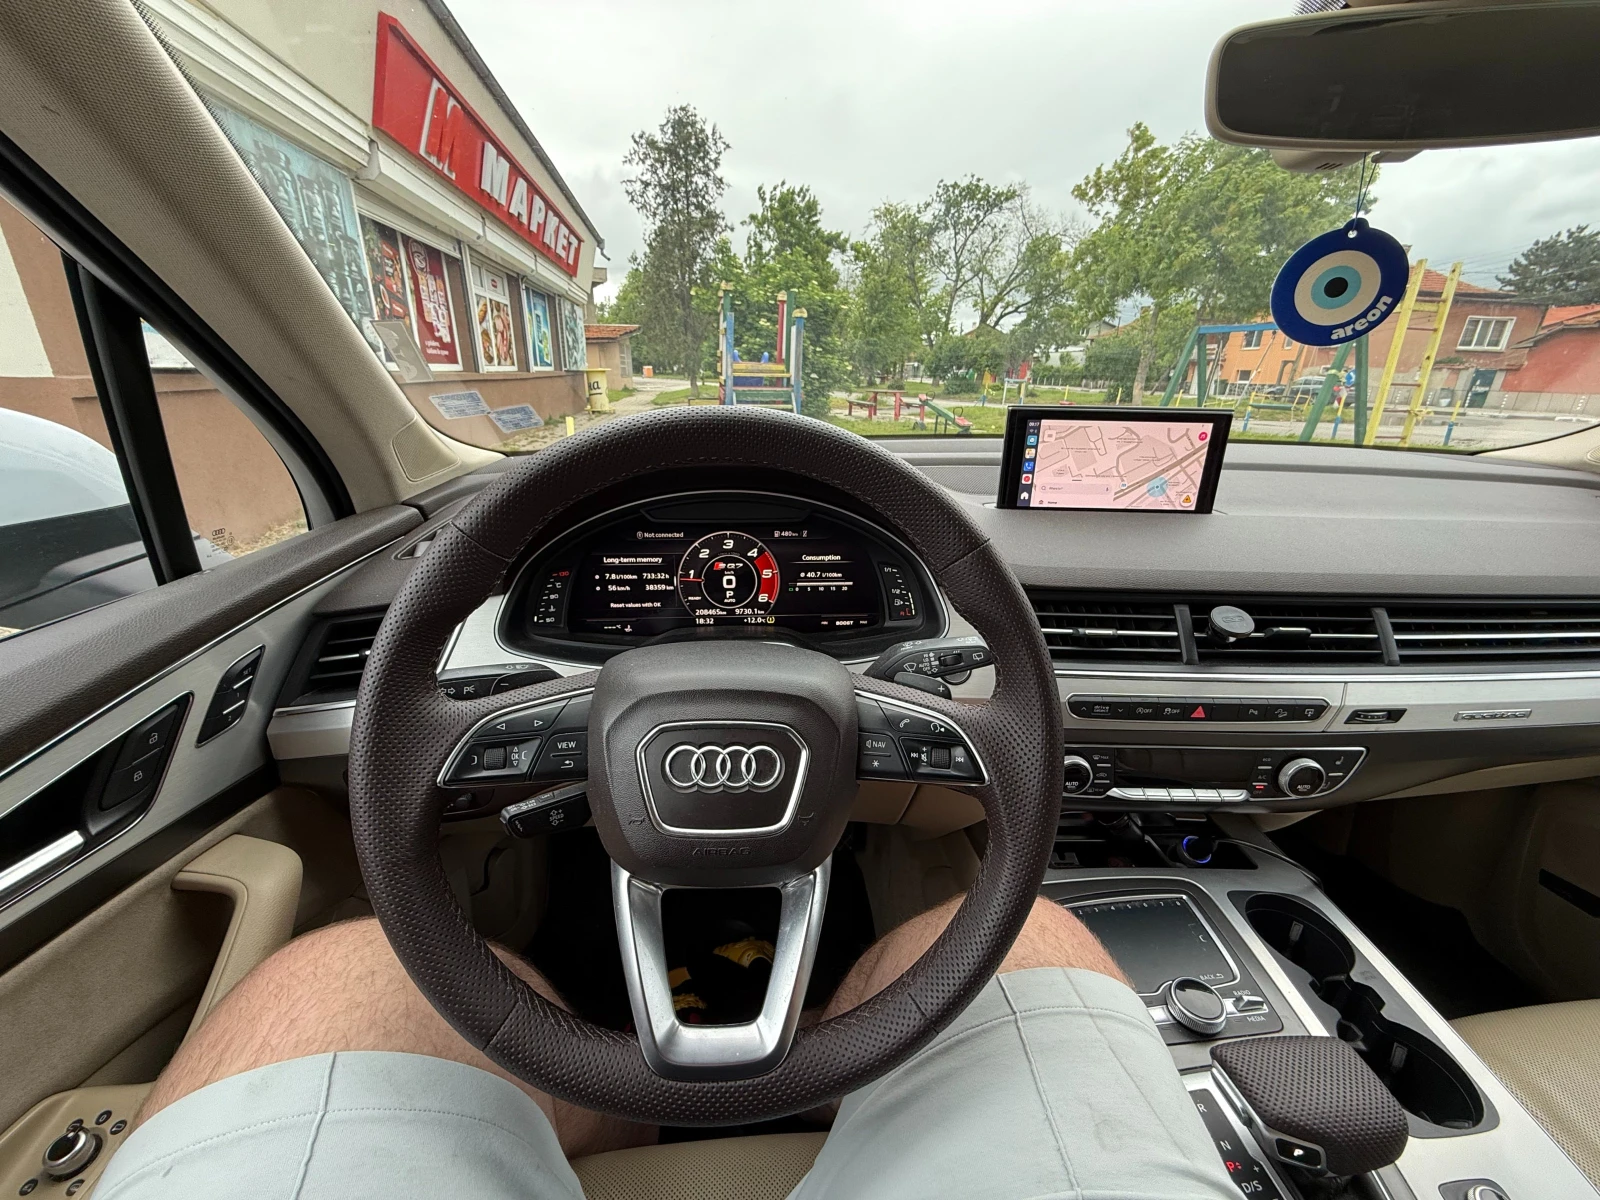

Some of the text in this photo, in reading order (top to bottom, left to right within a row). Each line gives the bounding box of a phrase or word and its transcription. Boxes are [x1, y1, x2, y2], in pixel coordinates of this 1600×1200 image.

[480, 140, 578, 266] МАРКЕТ
[1330, 295, 1393, 340] areon
[722, 539, 734, 549] 3
[698, 549, 710, 558] 2
[747, 548, 758, 557] 4
[688, 569, 695, 579] 1
[761, 569, 773, 578] 5
[722, 575, 736, 589] 0
[726, 590, 734, 598] P
[758, 593, 769, 602] 6
[556, 741, 577, 749] VIEW
[549, 813, 564, 821] SPEED
[692, 847, 750, 856] AIRBAG
[1199, 973, 1215, 981] BACK
[1196, 1103, 1207, 1113] R
[1220, 1140, 1231, 1151] N
[1293, 1148, 1304, 1157] P
[1226, 1161, 1235, 1172] P
[1241, 1180, 1263, 1194] D/S
